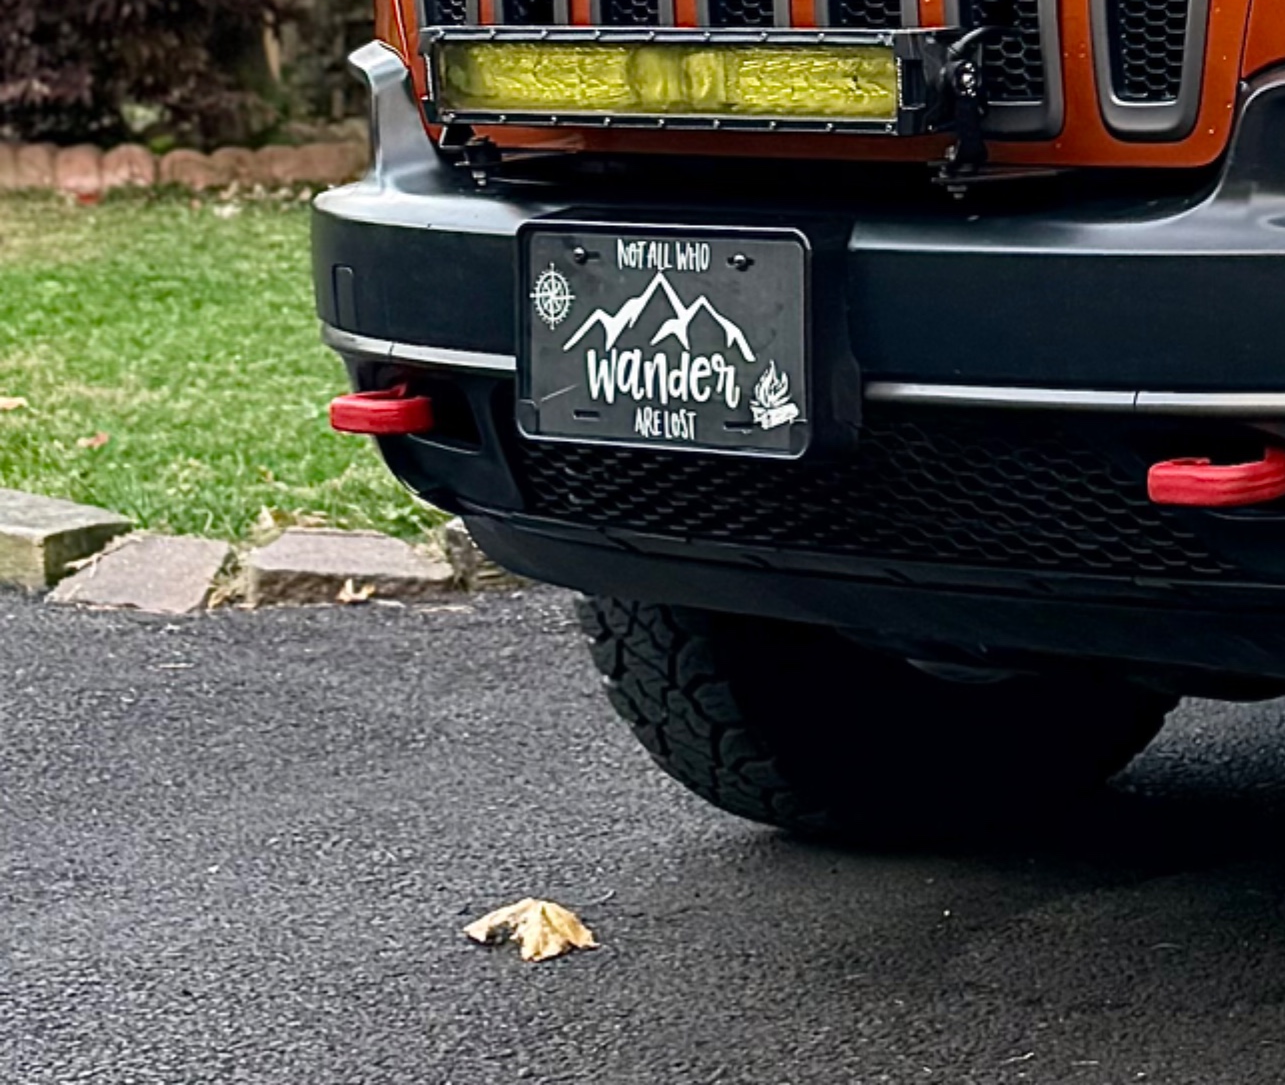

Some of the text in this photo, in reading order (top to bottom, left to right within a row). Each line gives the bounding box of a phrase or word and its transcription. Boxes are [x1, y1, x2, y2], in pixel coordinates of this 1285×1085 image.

[617, 238, 711, 272] NOT ALL WHO
[634, 406, 697, 441] ARE LOST
